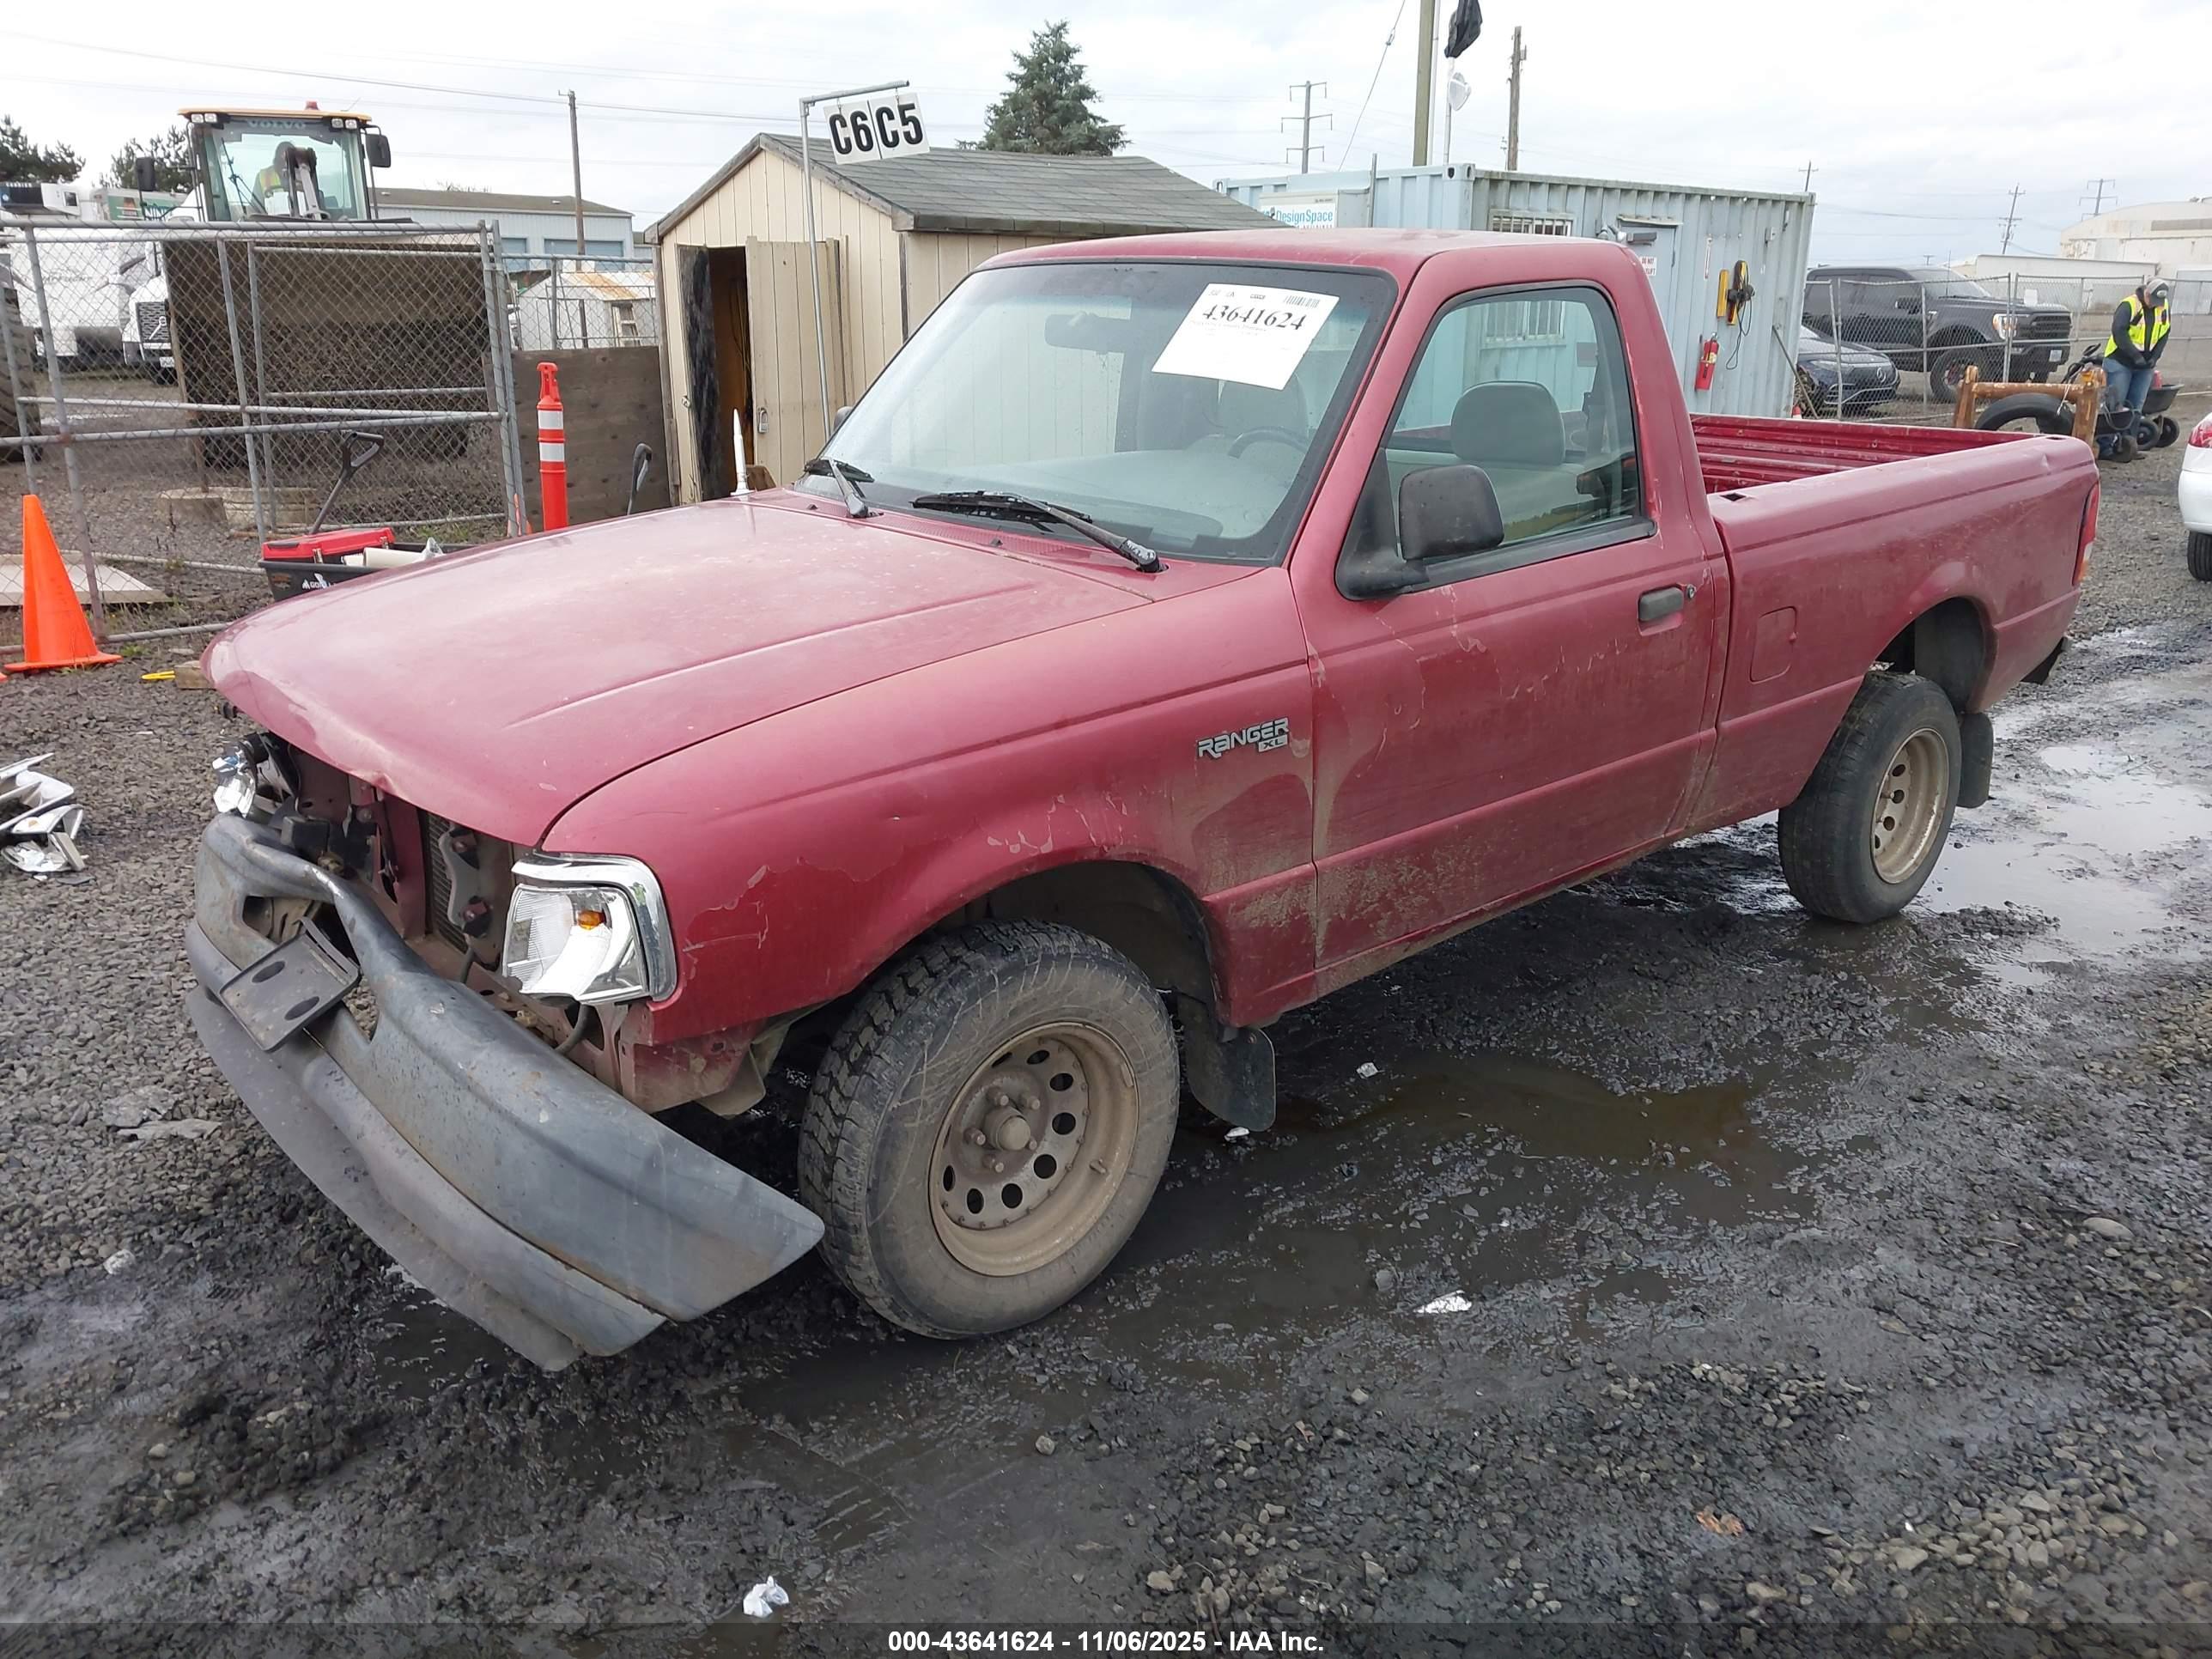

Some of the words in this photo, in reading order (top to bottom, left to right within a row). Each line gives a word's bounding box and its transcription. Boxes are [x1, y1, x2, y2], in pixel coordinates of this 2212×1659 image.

[1202, 304, 1307, 331] 43641624
[1197, 716, 1290, 759] RANGER
[1263, 737, 1285, 750] XL
